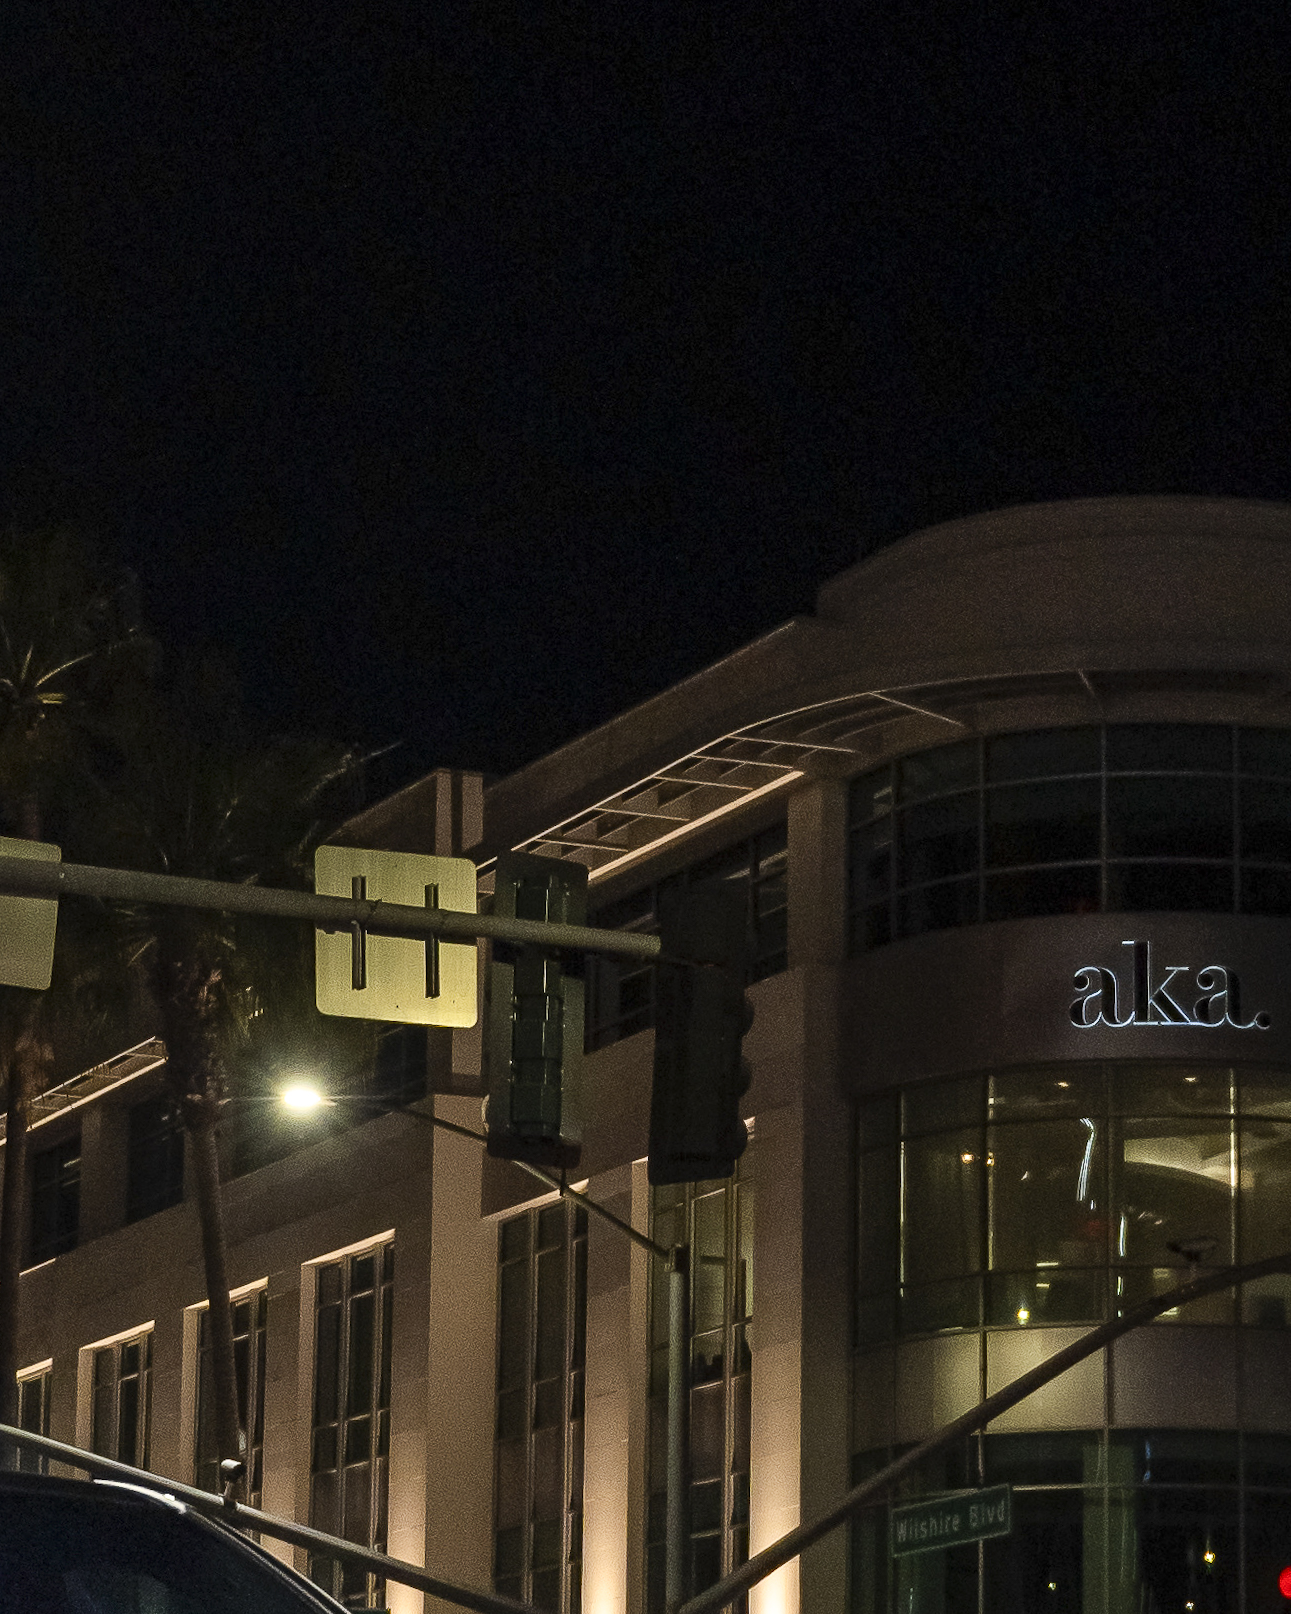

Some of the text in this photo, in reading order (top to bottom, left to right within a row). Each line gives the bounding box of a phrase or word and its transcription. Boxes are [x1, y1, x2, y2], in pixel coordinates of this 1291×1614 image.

[1068, 940, 1271, 1029] aka.
[896, 1499, 1005, 1542] Wilshire Blvd
